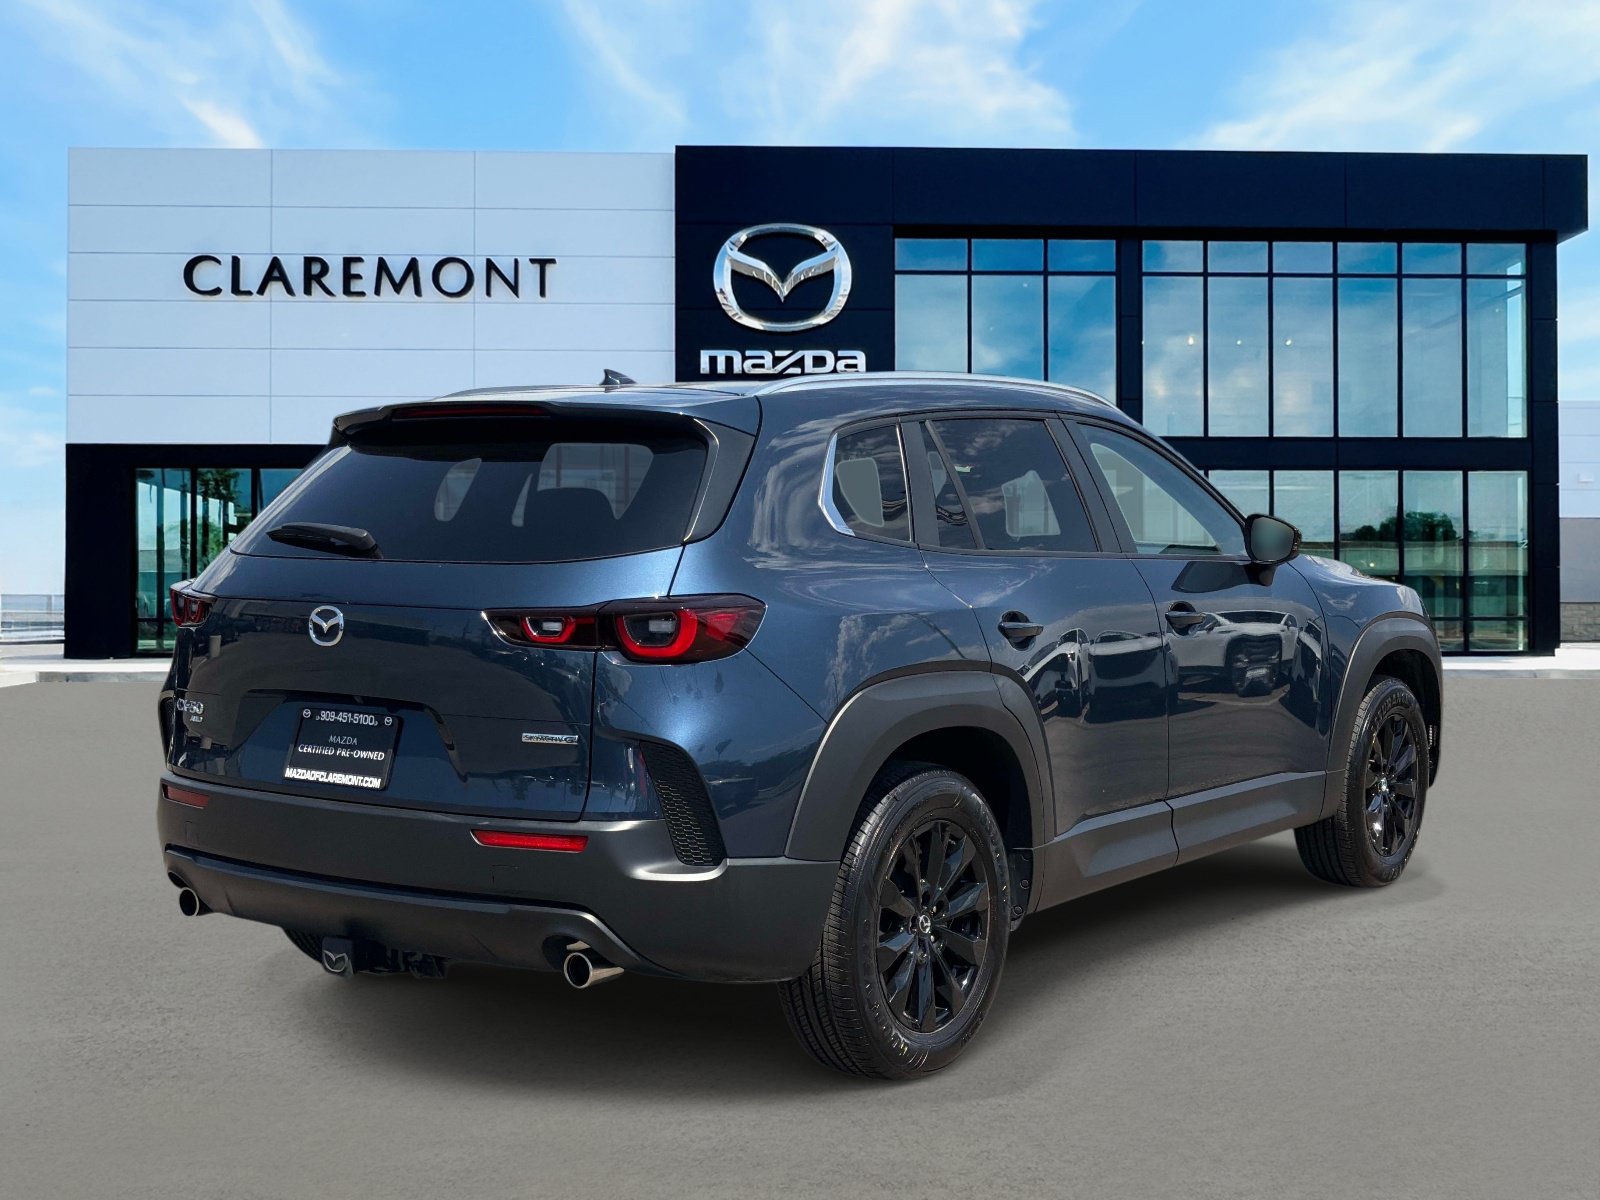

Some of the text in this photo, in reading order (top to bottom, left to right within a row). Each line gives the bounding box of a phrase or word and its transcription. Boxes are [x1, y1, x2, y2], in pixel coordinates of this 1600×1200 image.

[183, 255, 557, 298] CLAREMONT
[700, 349, 867, 374] mazda
[320, 710, 375, 726] 909-451-5100
[328, 735, 358, 746] MAZDA
[298, 743, 385, 761] CERTIFIED PRE-OWNED
[285, 767, 382, 789] MAZDAOFCLAREMONT.COM
